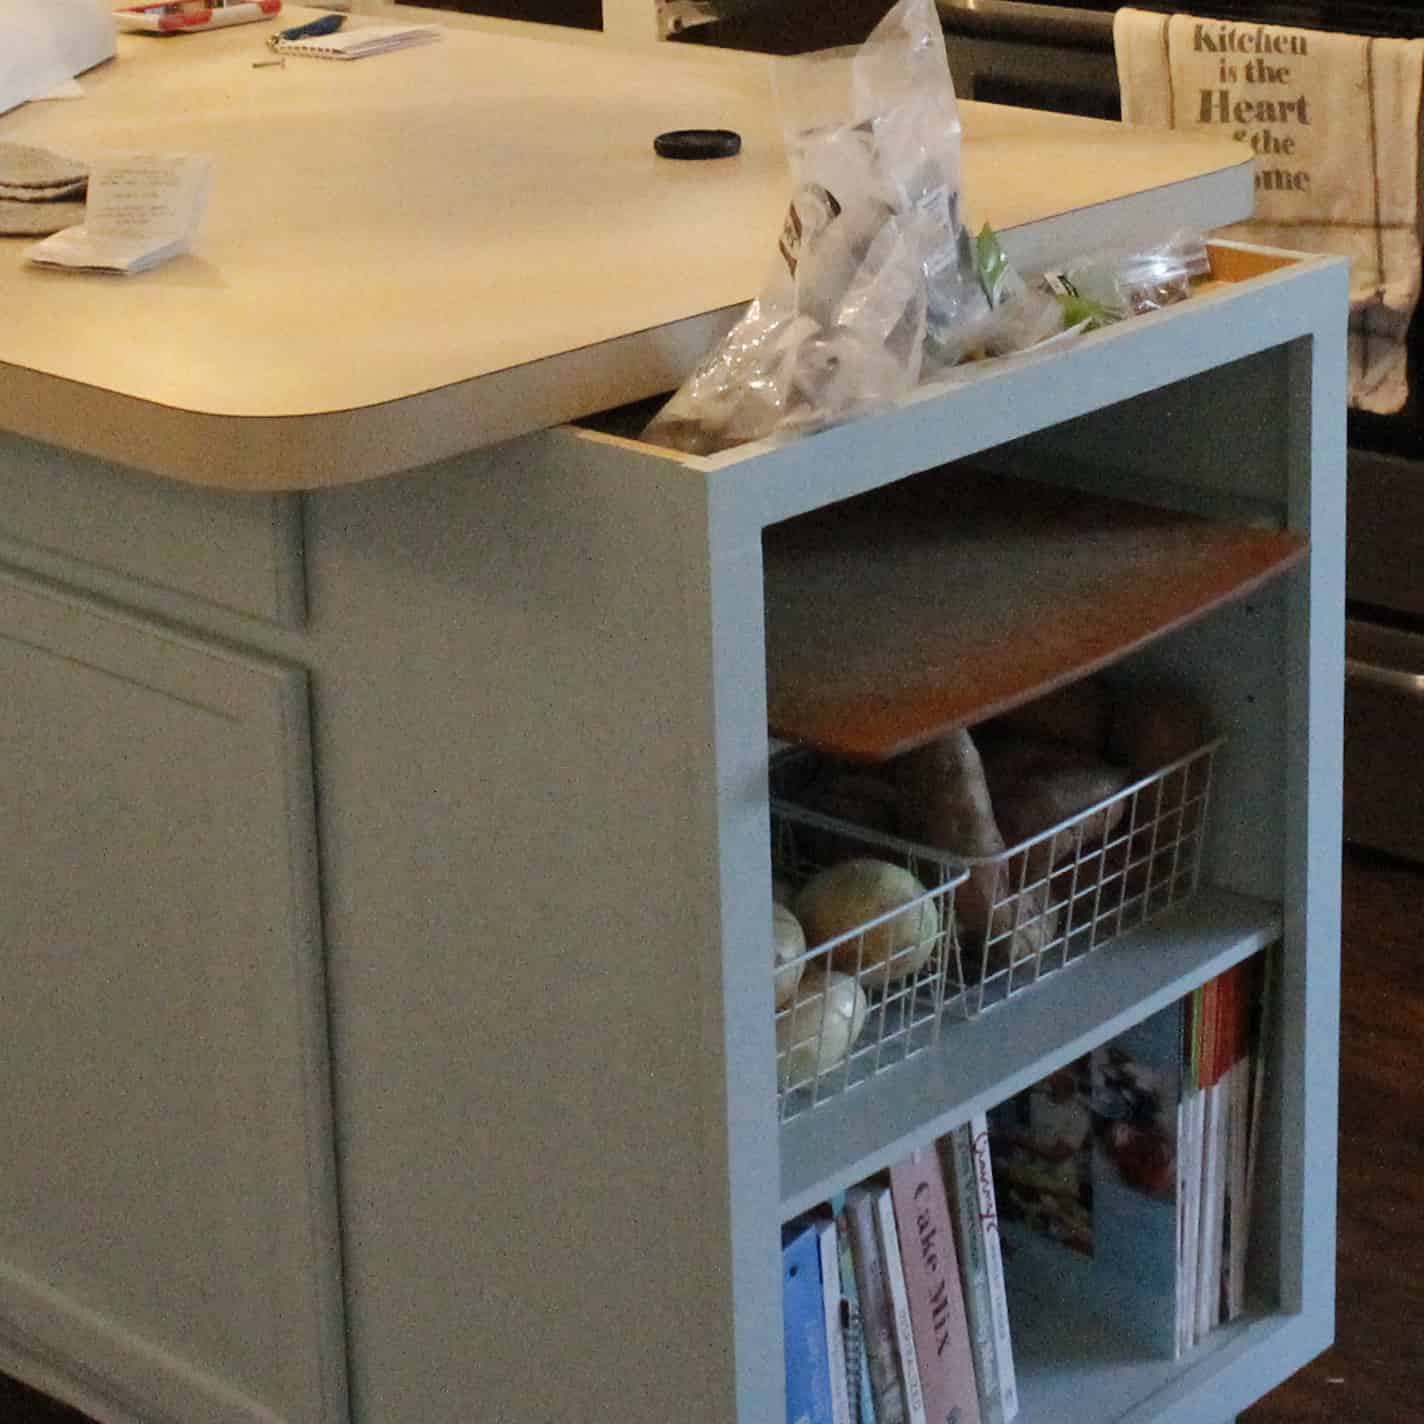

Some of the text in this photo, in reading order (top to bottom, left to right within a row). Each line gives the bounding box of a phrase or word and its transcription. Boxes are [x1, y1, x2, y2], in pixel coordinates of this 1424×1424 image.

[1193, 23, 1309, 56] Kitchen
[1218, 58, 1291, 85] is the
[1196, 88, 1312, 126] Heart
[1250, 128, 1296, 156] the
[913, 1180, 950, 1358] Cake Mix
